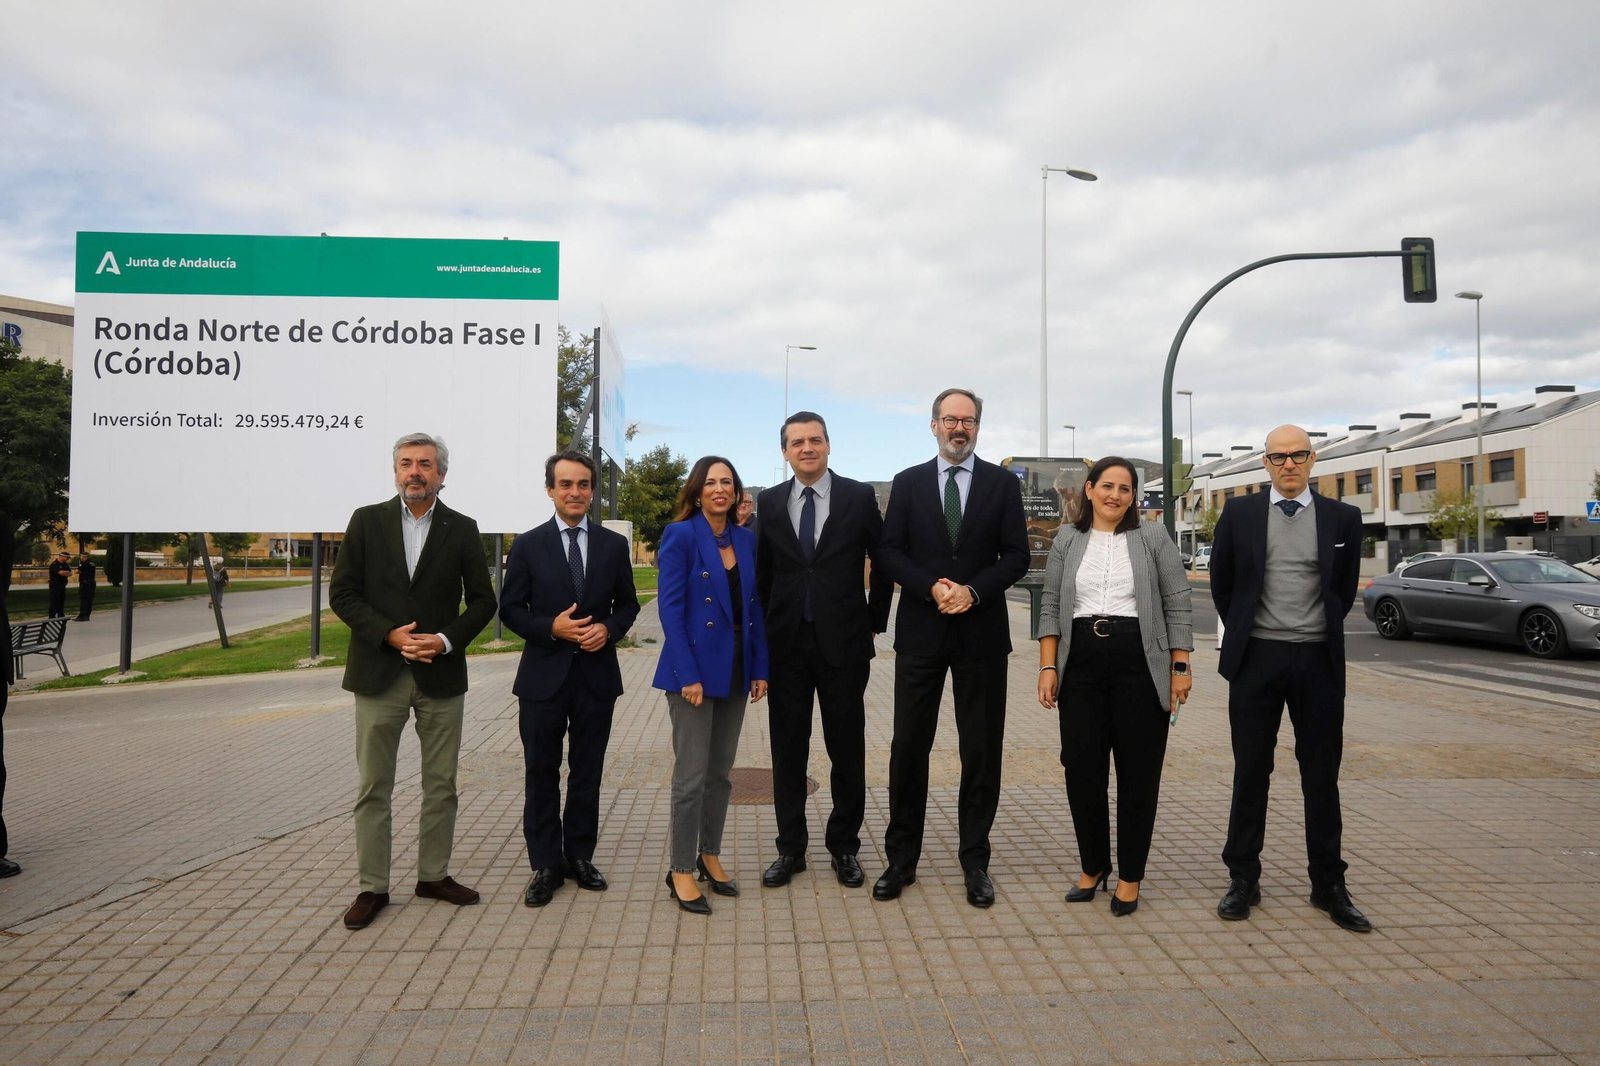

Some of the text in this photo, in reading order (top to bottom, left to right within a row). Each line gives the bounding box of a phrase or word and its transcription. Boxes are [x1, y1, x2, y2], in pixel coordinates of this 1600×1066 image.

[125, 256, 237, 269] Junta de Andalucía
[436, 264, 542, 274] www.juntadeandalucia.es
[94, 316, 541, 346] Ronda Norte de Córdoba Fase I
[93, 347, 242, 381] (Córdoba)
[92, 411, 364, 431] Inversión Total: 29.595.479,24 €
